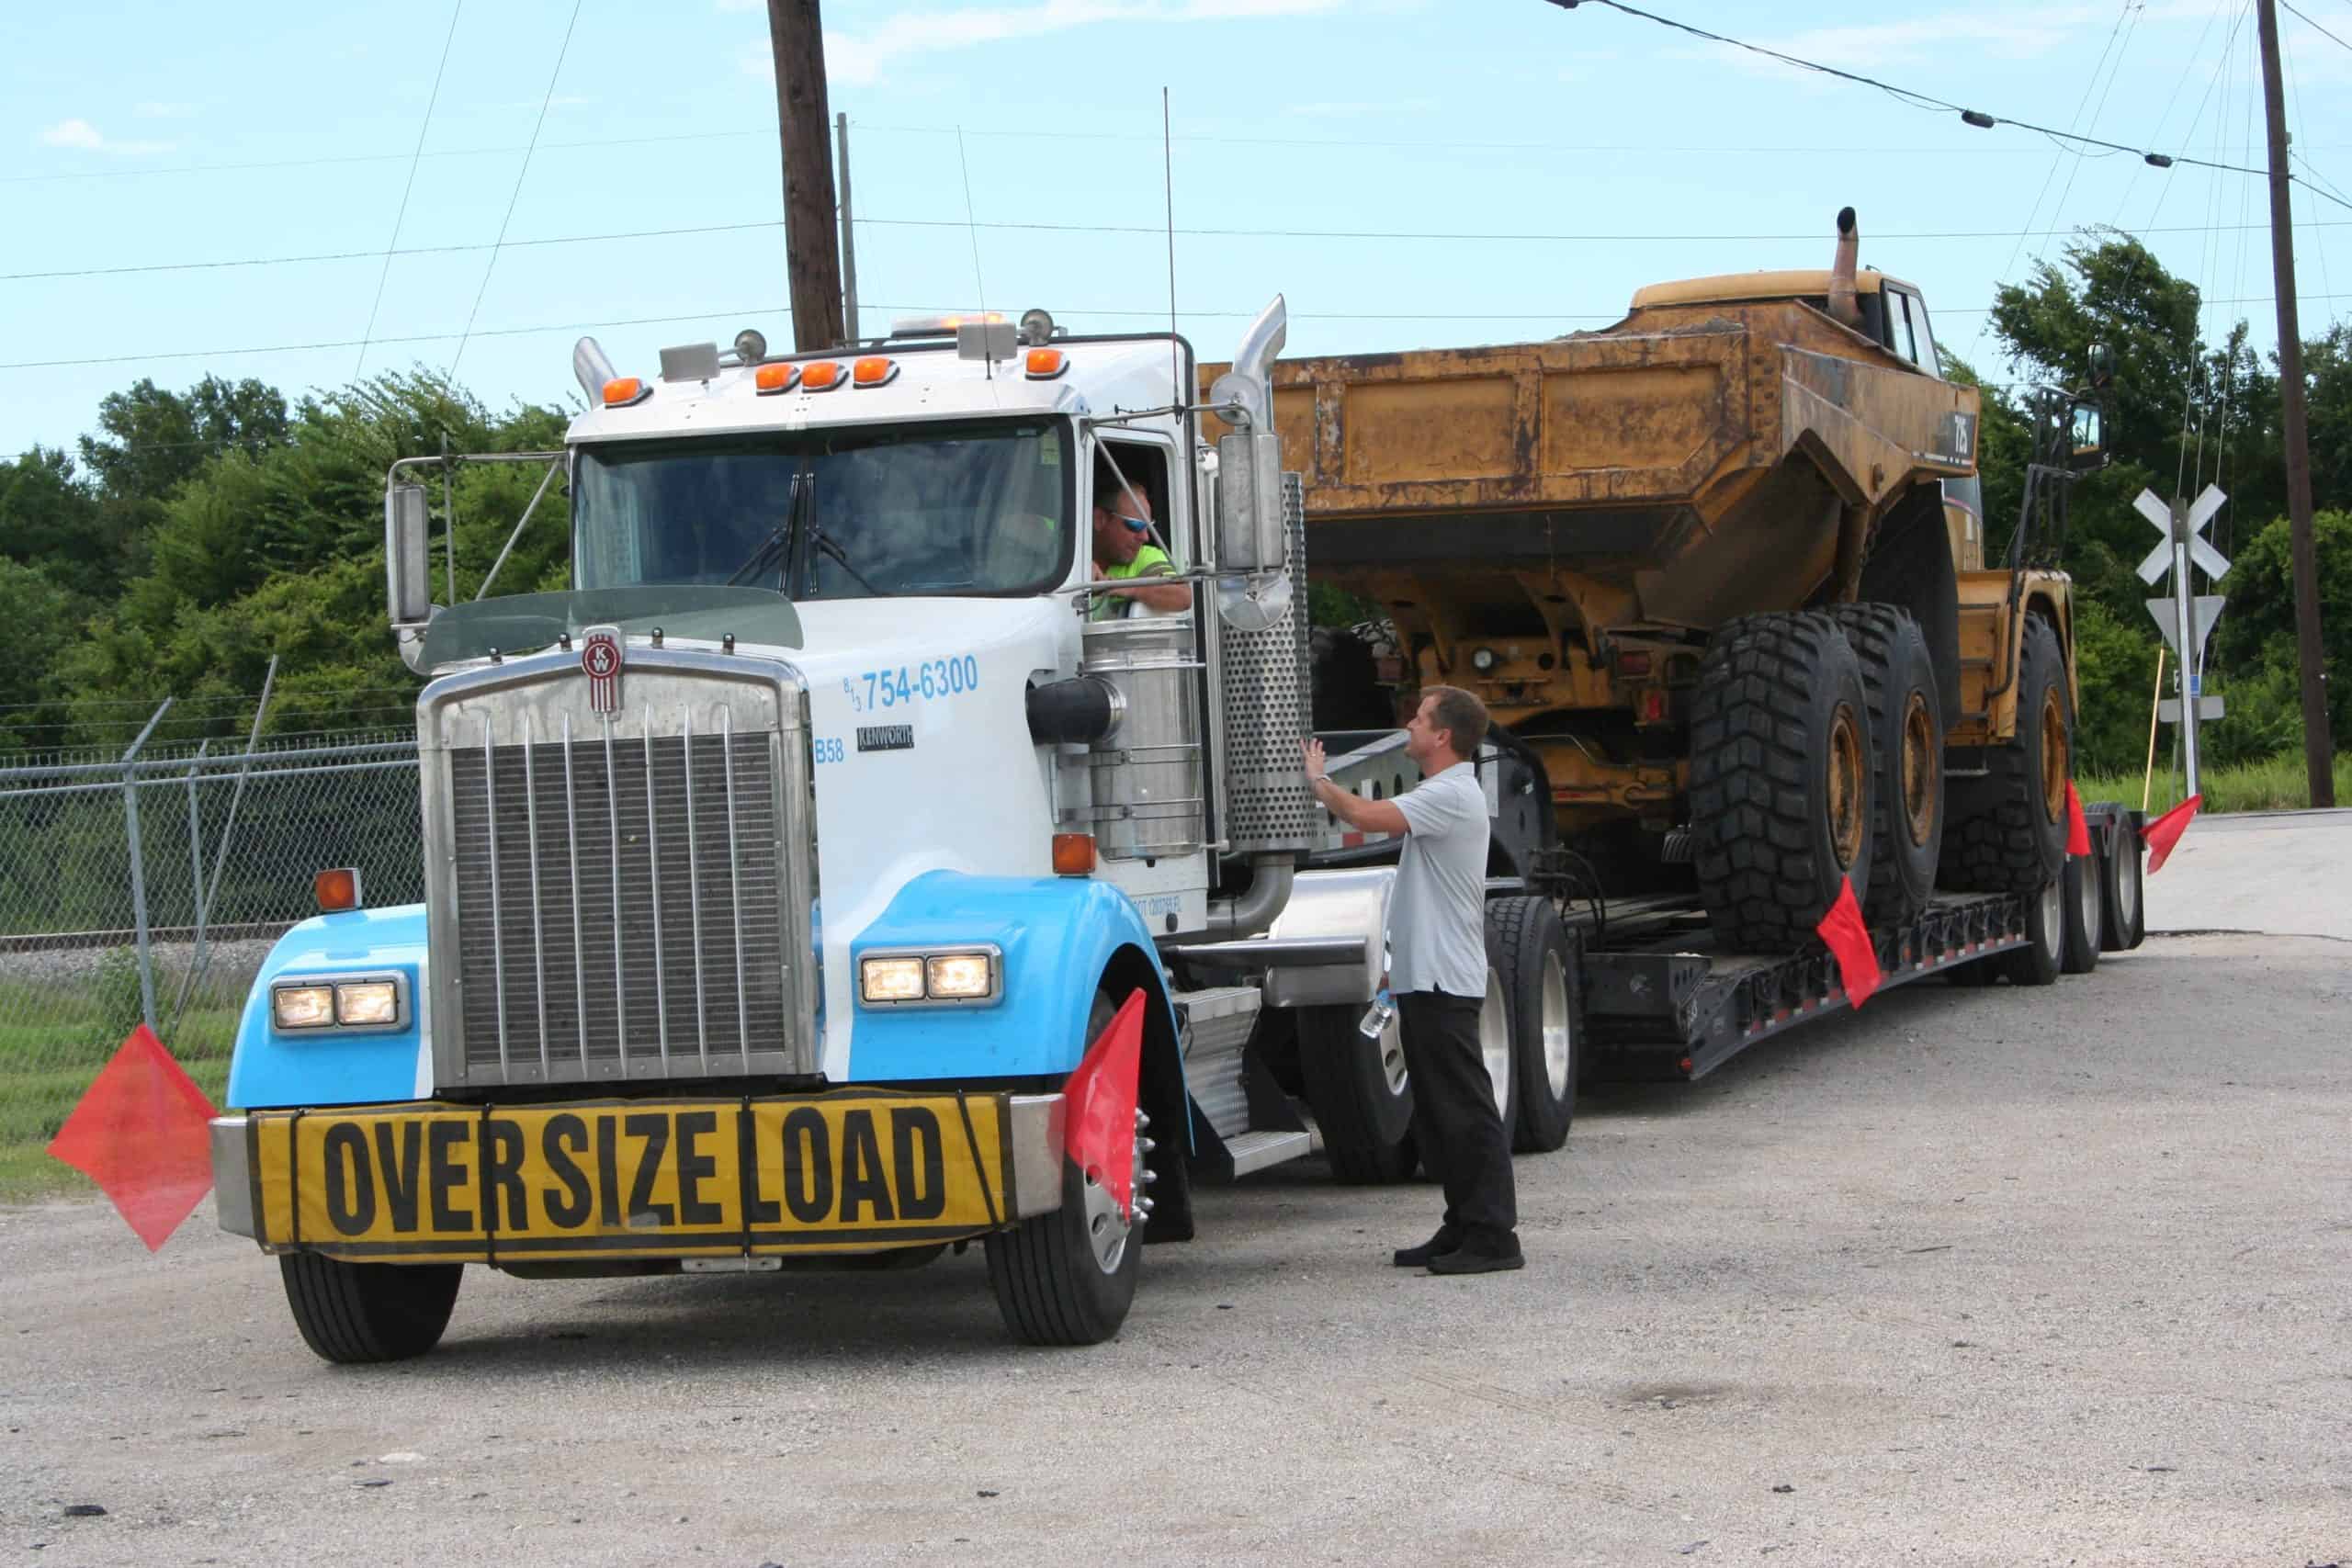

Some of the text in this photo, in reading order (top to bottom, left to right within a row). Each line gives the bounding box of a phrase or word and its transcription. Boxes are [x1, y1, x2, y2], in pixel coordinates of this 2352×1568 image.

[862, 654, 978, 710] 754-6300
[814, 738, 844, 764] B58
[858, 725, 913, 746] KENWORTH
[737, 1107, 946, 1224] LOAD
